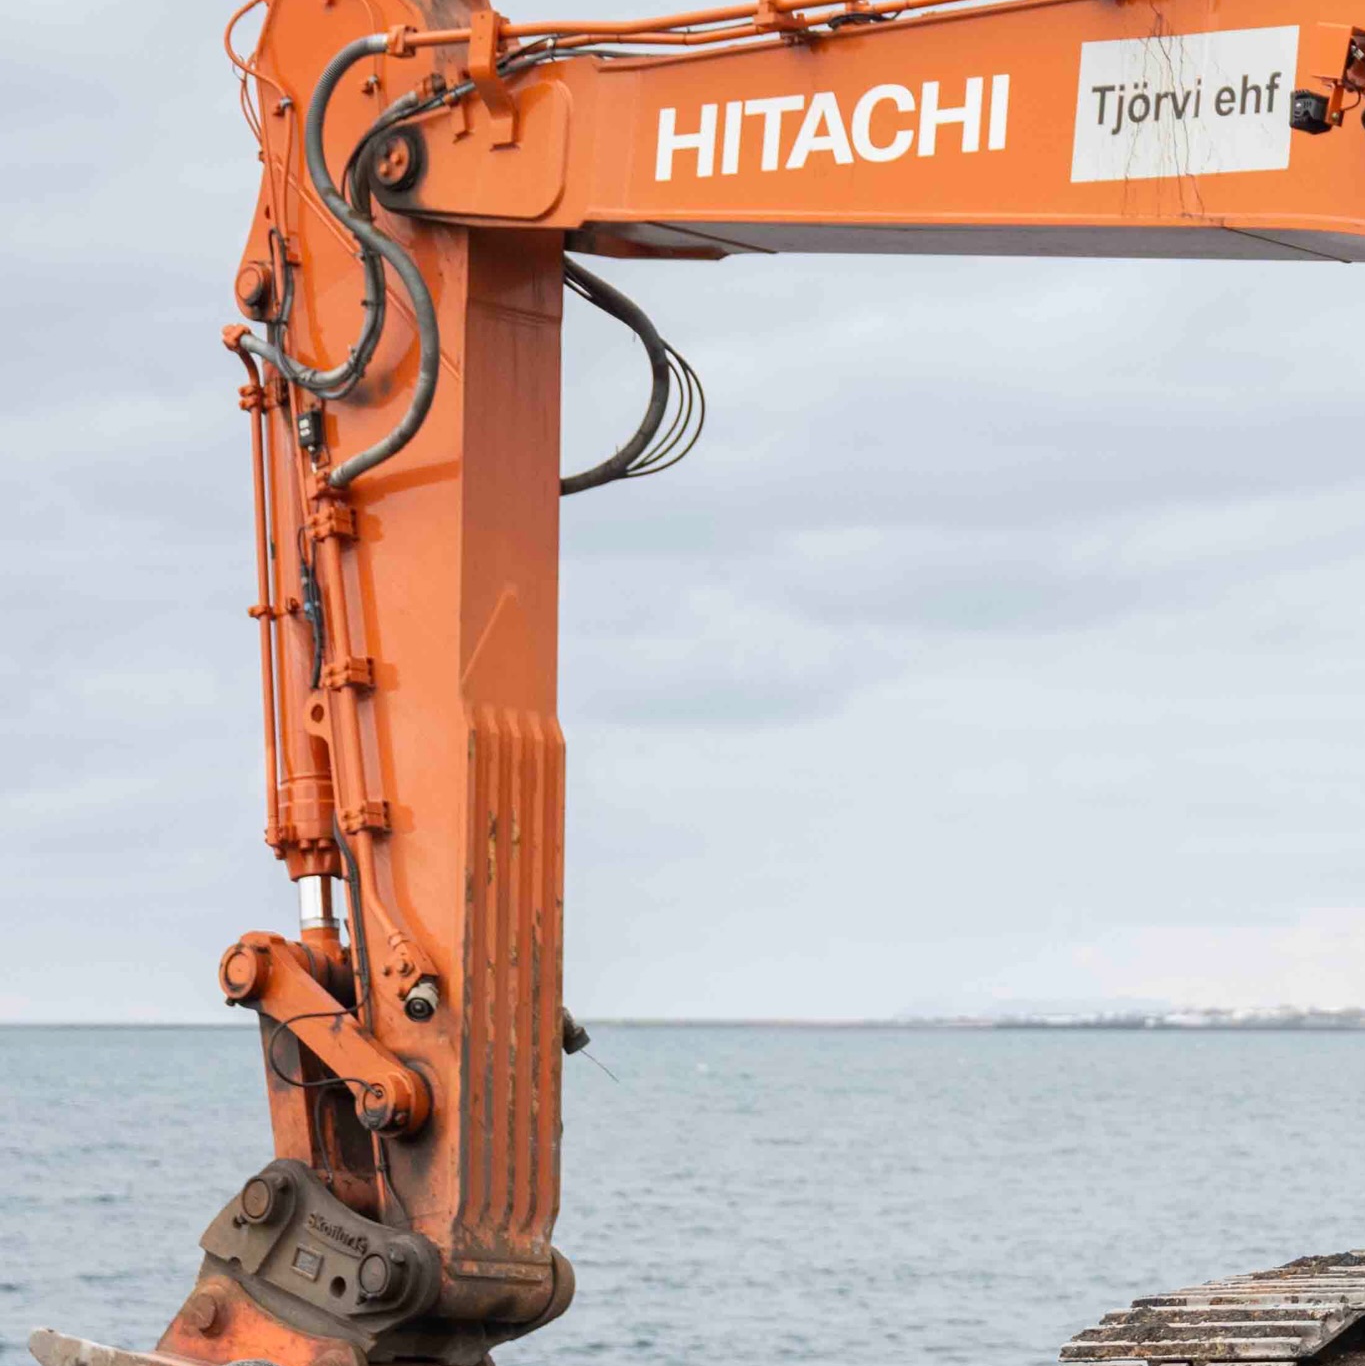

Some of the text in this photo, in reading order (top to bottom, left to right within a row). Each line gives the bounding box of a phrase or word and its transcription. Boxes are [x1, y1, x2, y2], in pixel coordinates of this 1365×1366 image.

[655, 74, 1010, 181] HITACHI
[1092, 72, 1281, 135] Tjörvi ehf
